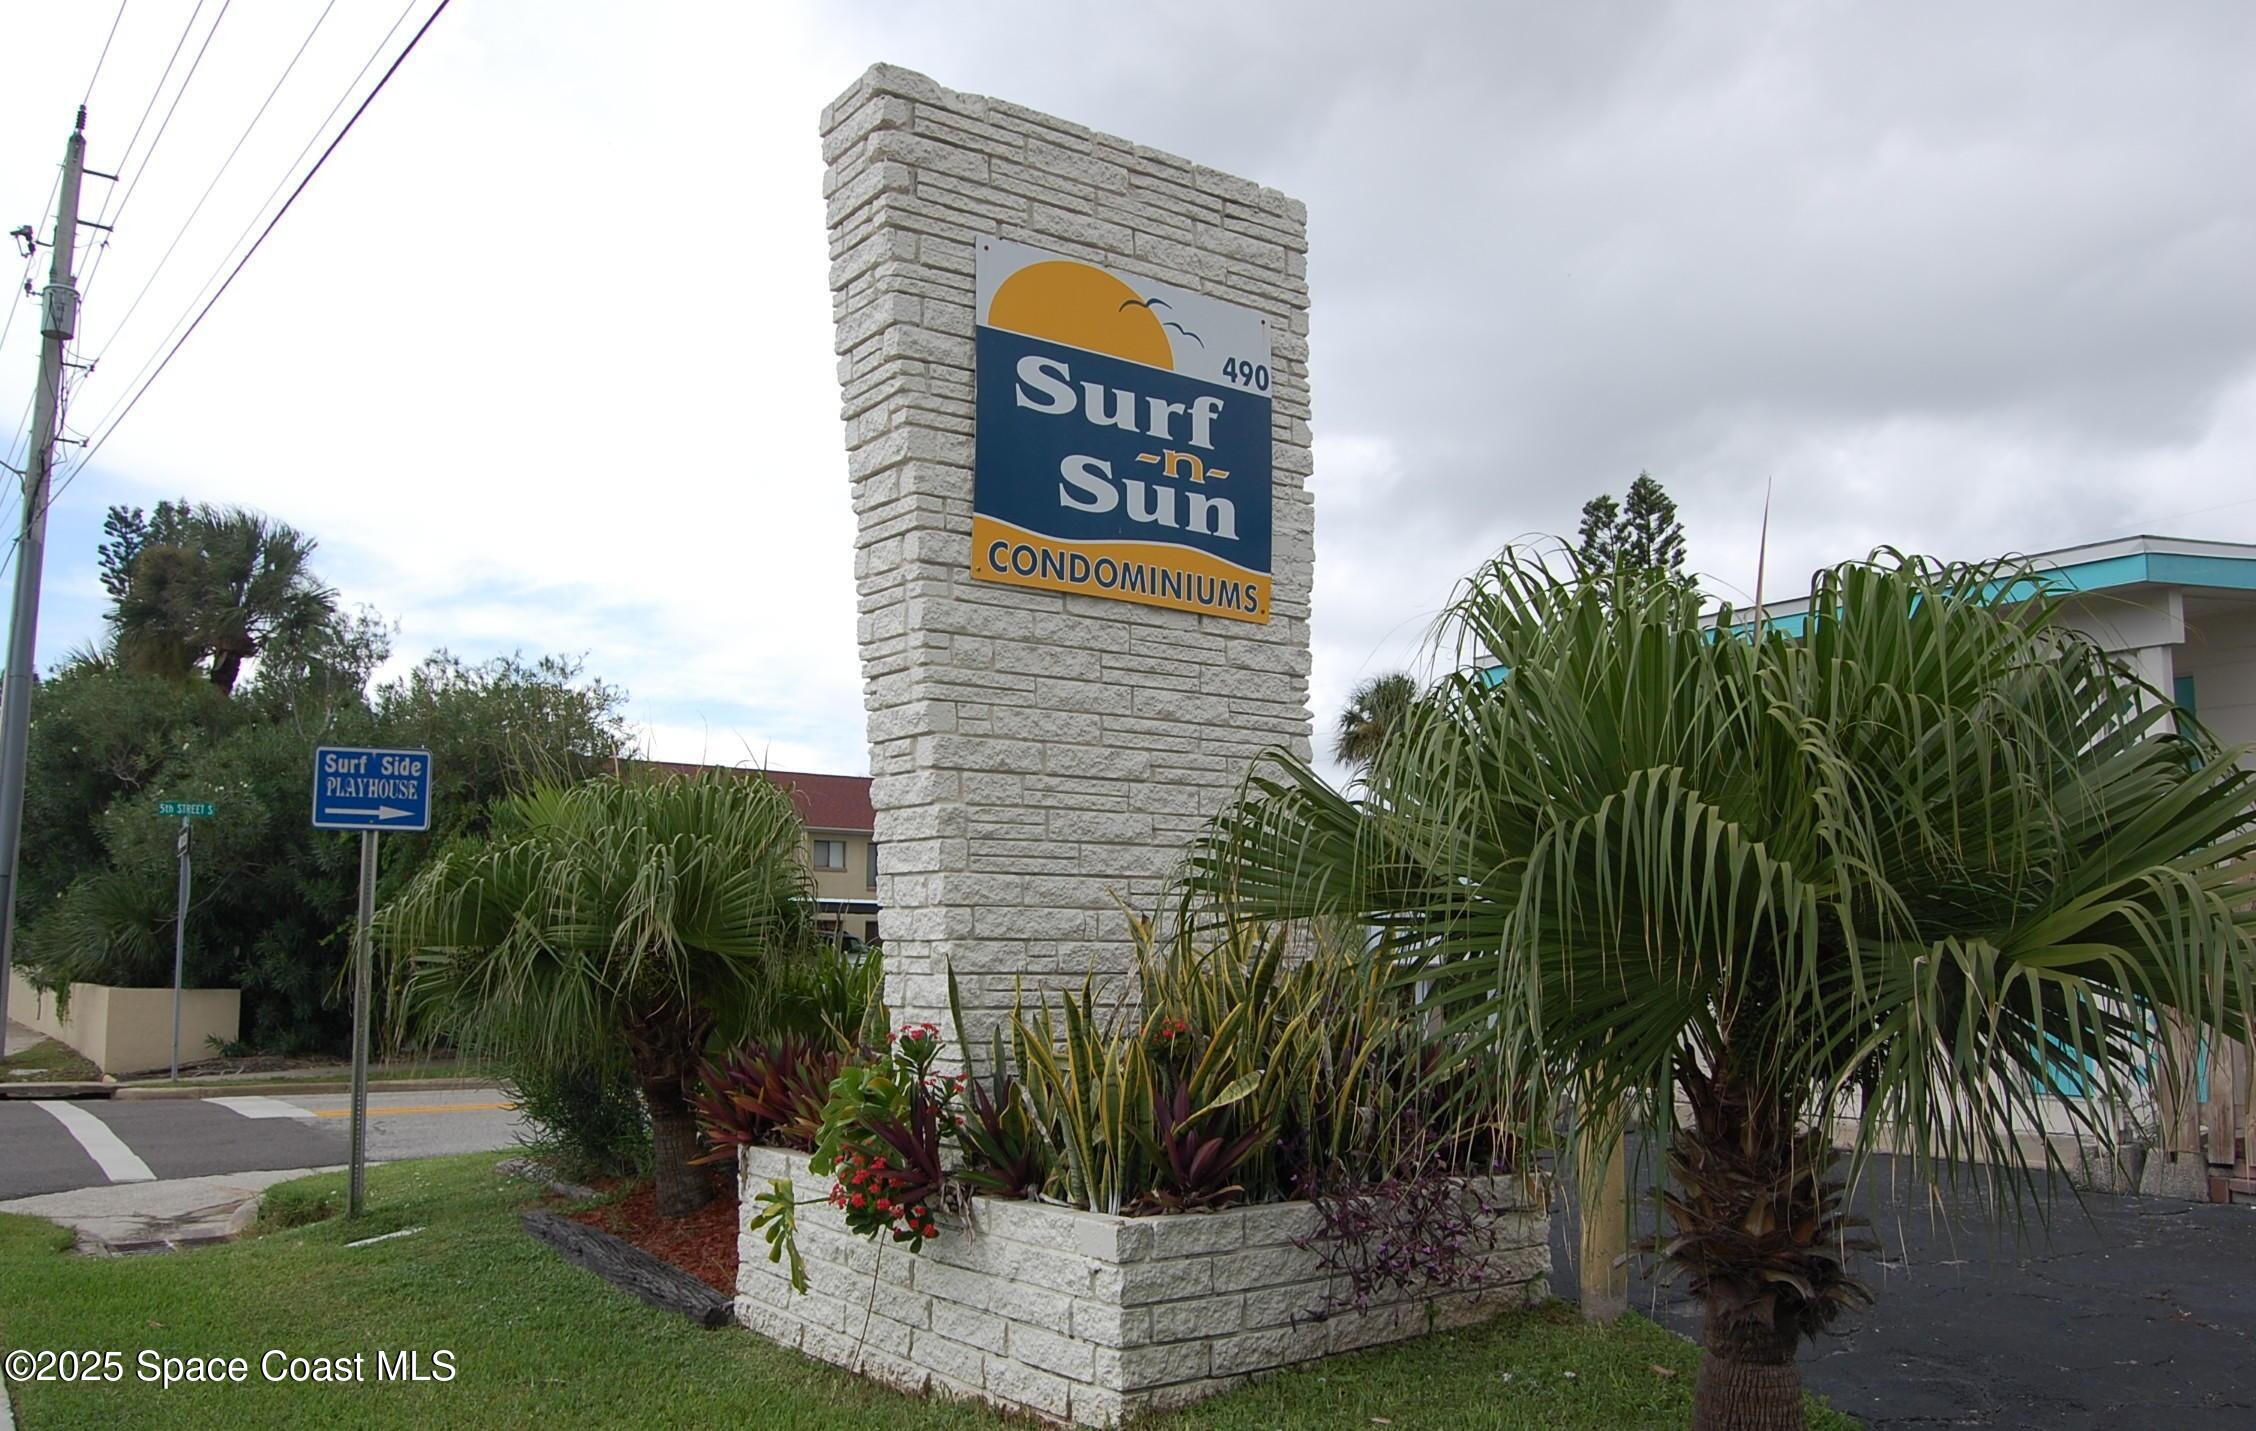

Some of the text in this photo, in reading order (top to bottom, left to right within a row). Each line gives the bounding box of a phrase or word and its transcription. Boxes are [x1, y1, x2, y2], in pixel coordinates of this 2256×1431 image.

[1223, 357, 1269, 391] 490
[1015, 355, 1224, 450] Surf
[1059, 454, 1240, 540] Sun
[988, 541, 1258, 613] CONDOMINIUMS
[325, 753, 421, 776] Surf Side
[326, 777, 418, 799] PLAYHOUSE
[160, 804, 213, 815] 5th STREET S
